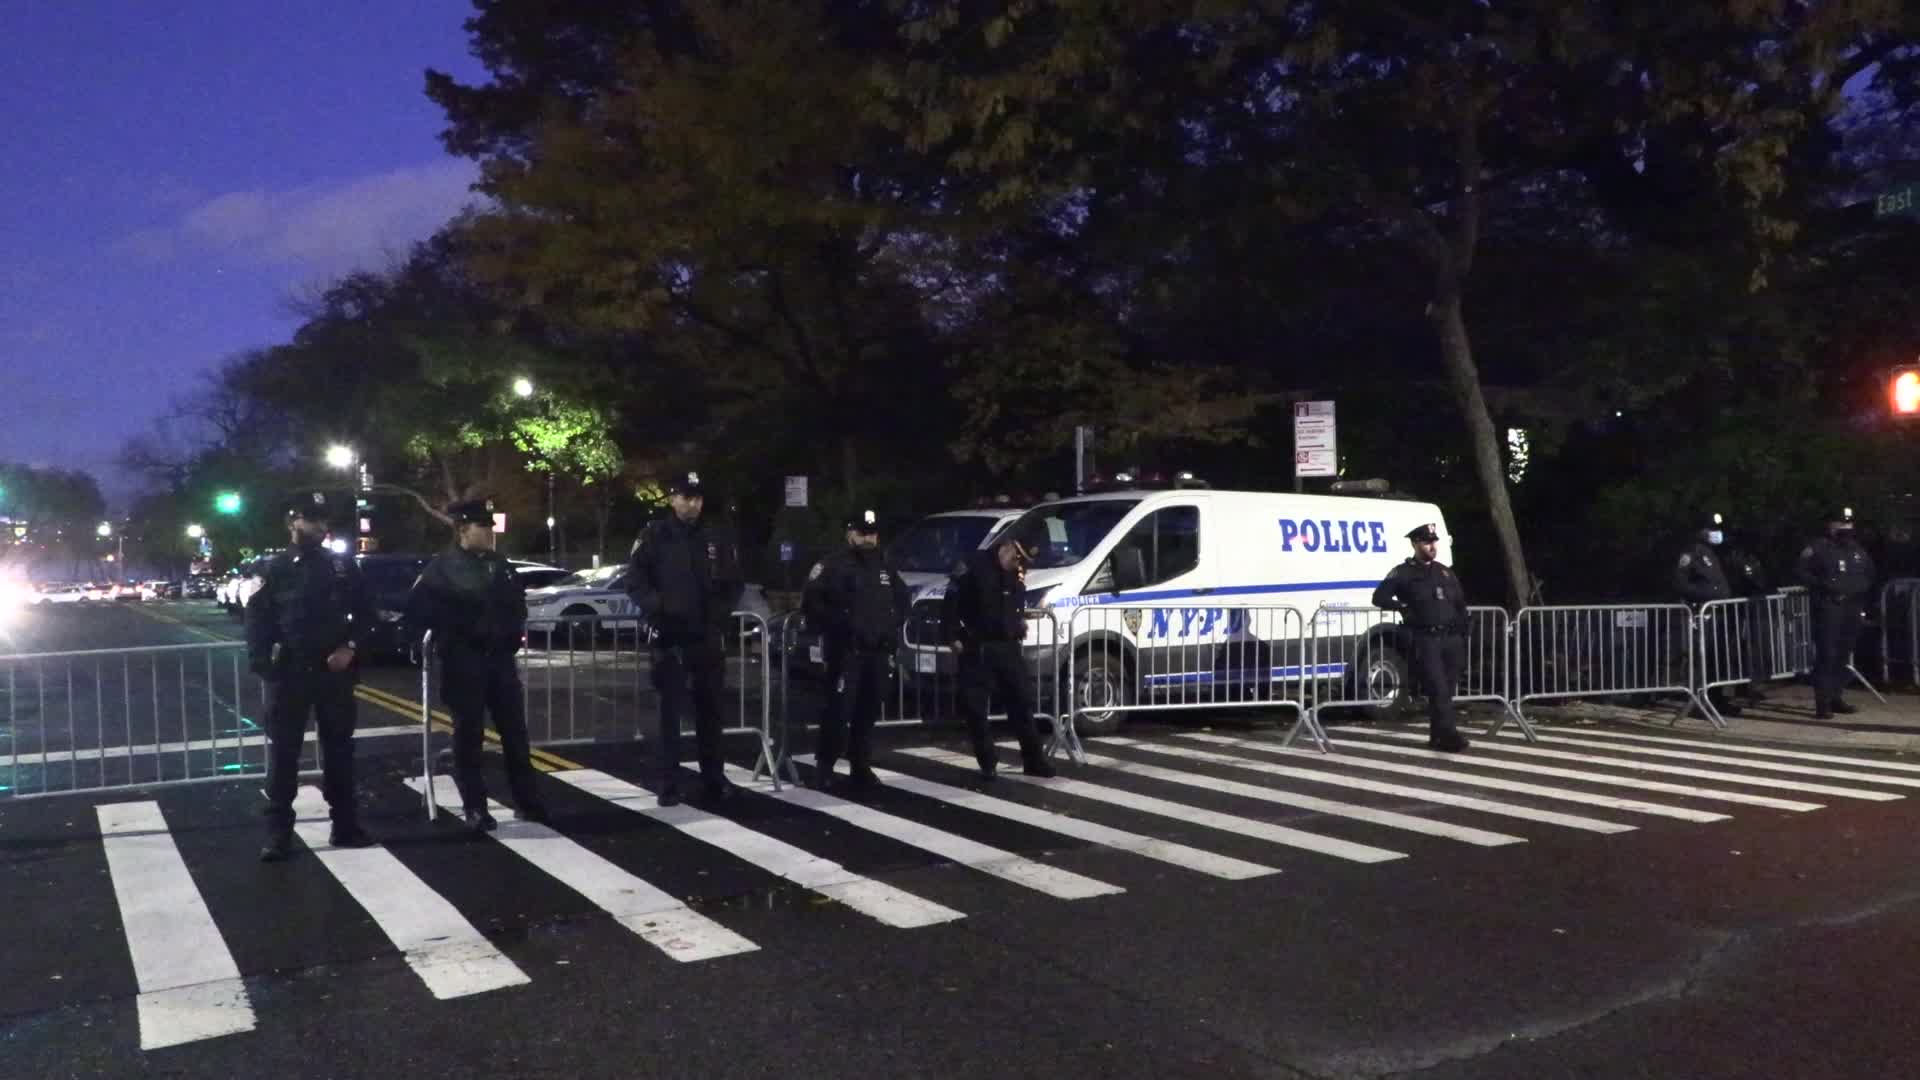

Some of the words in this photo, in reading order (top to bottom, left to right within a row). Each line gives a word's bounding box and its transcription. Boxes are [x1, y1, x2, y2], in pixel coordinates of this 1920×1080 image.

[1877, 187, 1912, 214] East
[1278, 518, 1387, 553] POLICE
[1064, 595, 1100, 607] POLICE
[1147, 605, 1245, 639] NYPD
